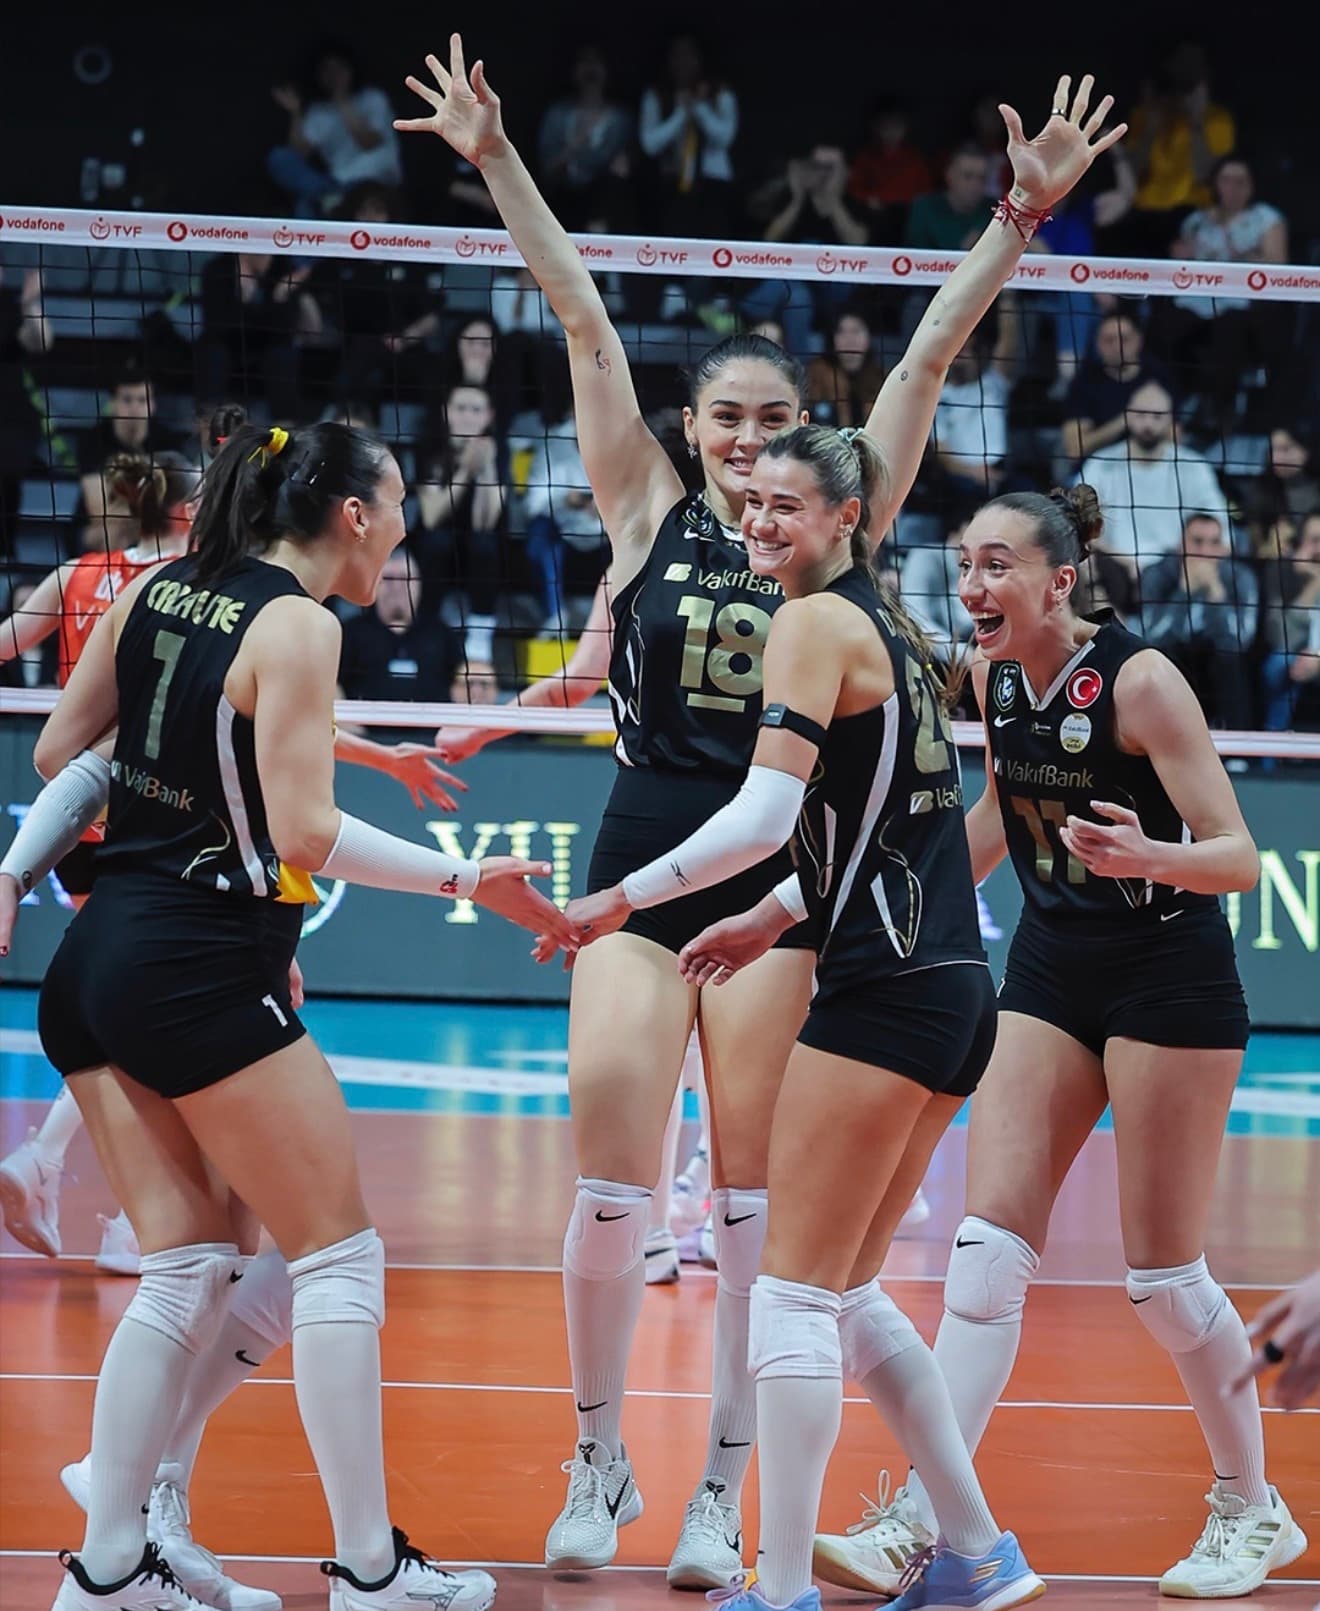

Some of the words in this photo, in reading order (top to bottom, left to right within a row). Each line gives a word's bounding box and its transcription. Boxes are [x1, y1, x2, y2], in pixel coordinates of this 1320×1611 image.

[7, 218, 65, 232] vodafone
[113, 224, 143, 237] TVF
[190, 226, 249, 241] vodafone
[296, 232, 326, 246] TVF
[373, 235, 432, 249] vodafone
[478, 242, 507, 255] TVF
[576, 244, 613, 258] afone
[661, 251, 688, 265] TVF
[735, 252, 793, 266] vodafone
[839, 259, 868, 272] TVF
[915, 259, 957, 273] vodafo
[1018, 266, 1046, 278] TVF
[1092, 268, 1150, 282] vodafone
[1194, 274, 1223, 287] TVF
[677, 595, 773, 696] 18
[144, 629, 187, 760] 1
[261, 993, 288, 1027] 1
